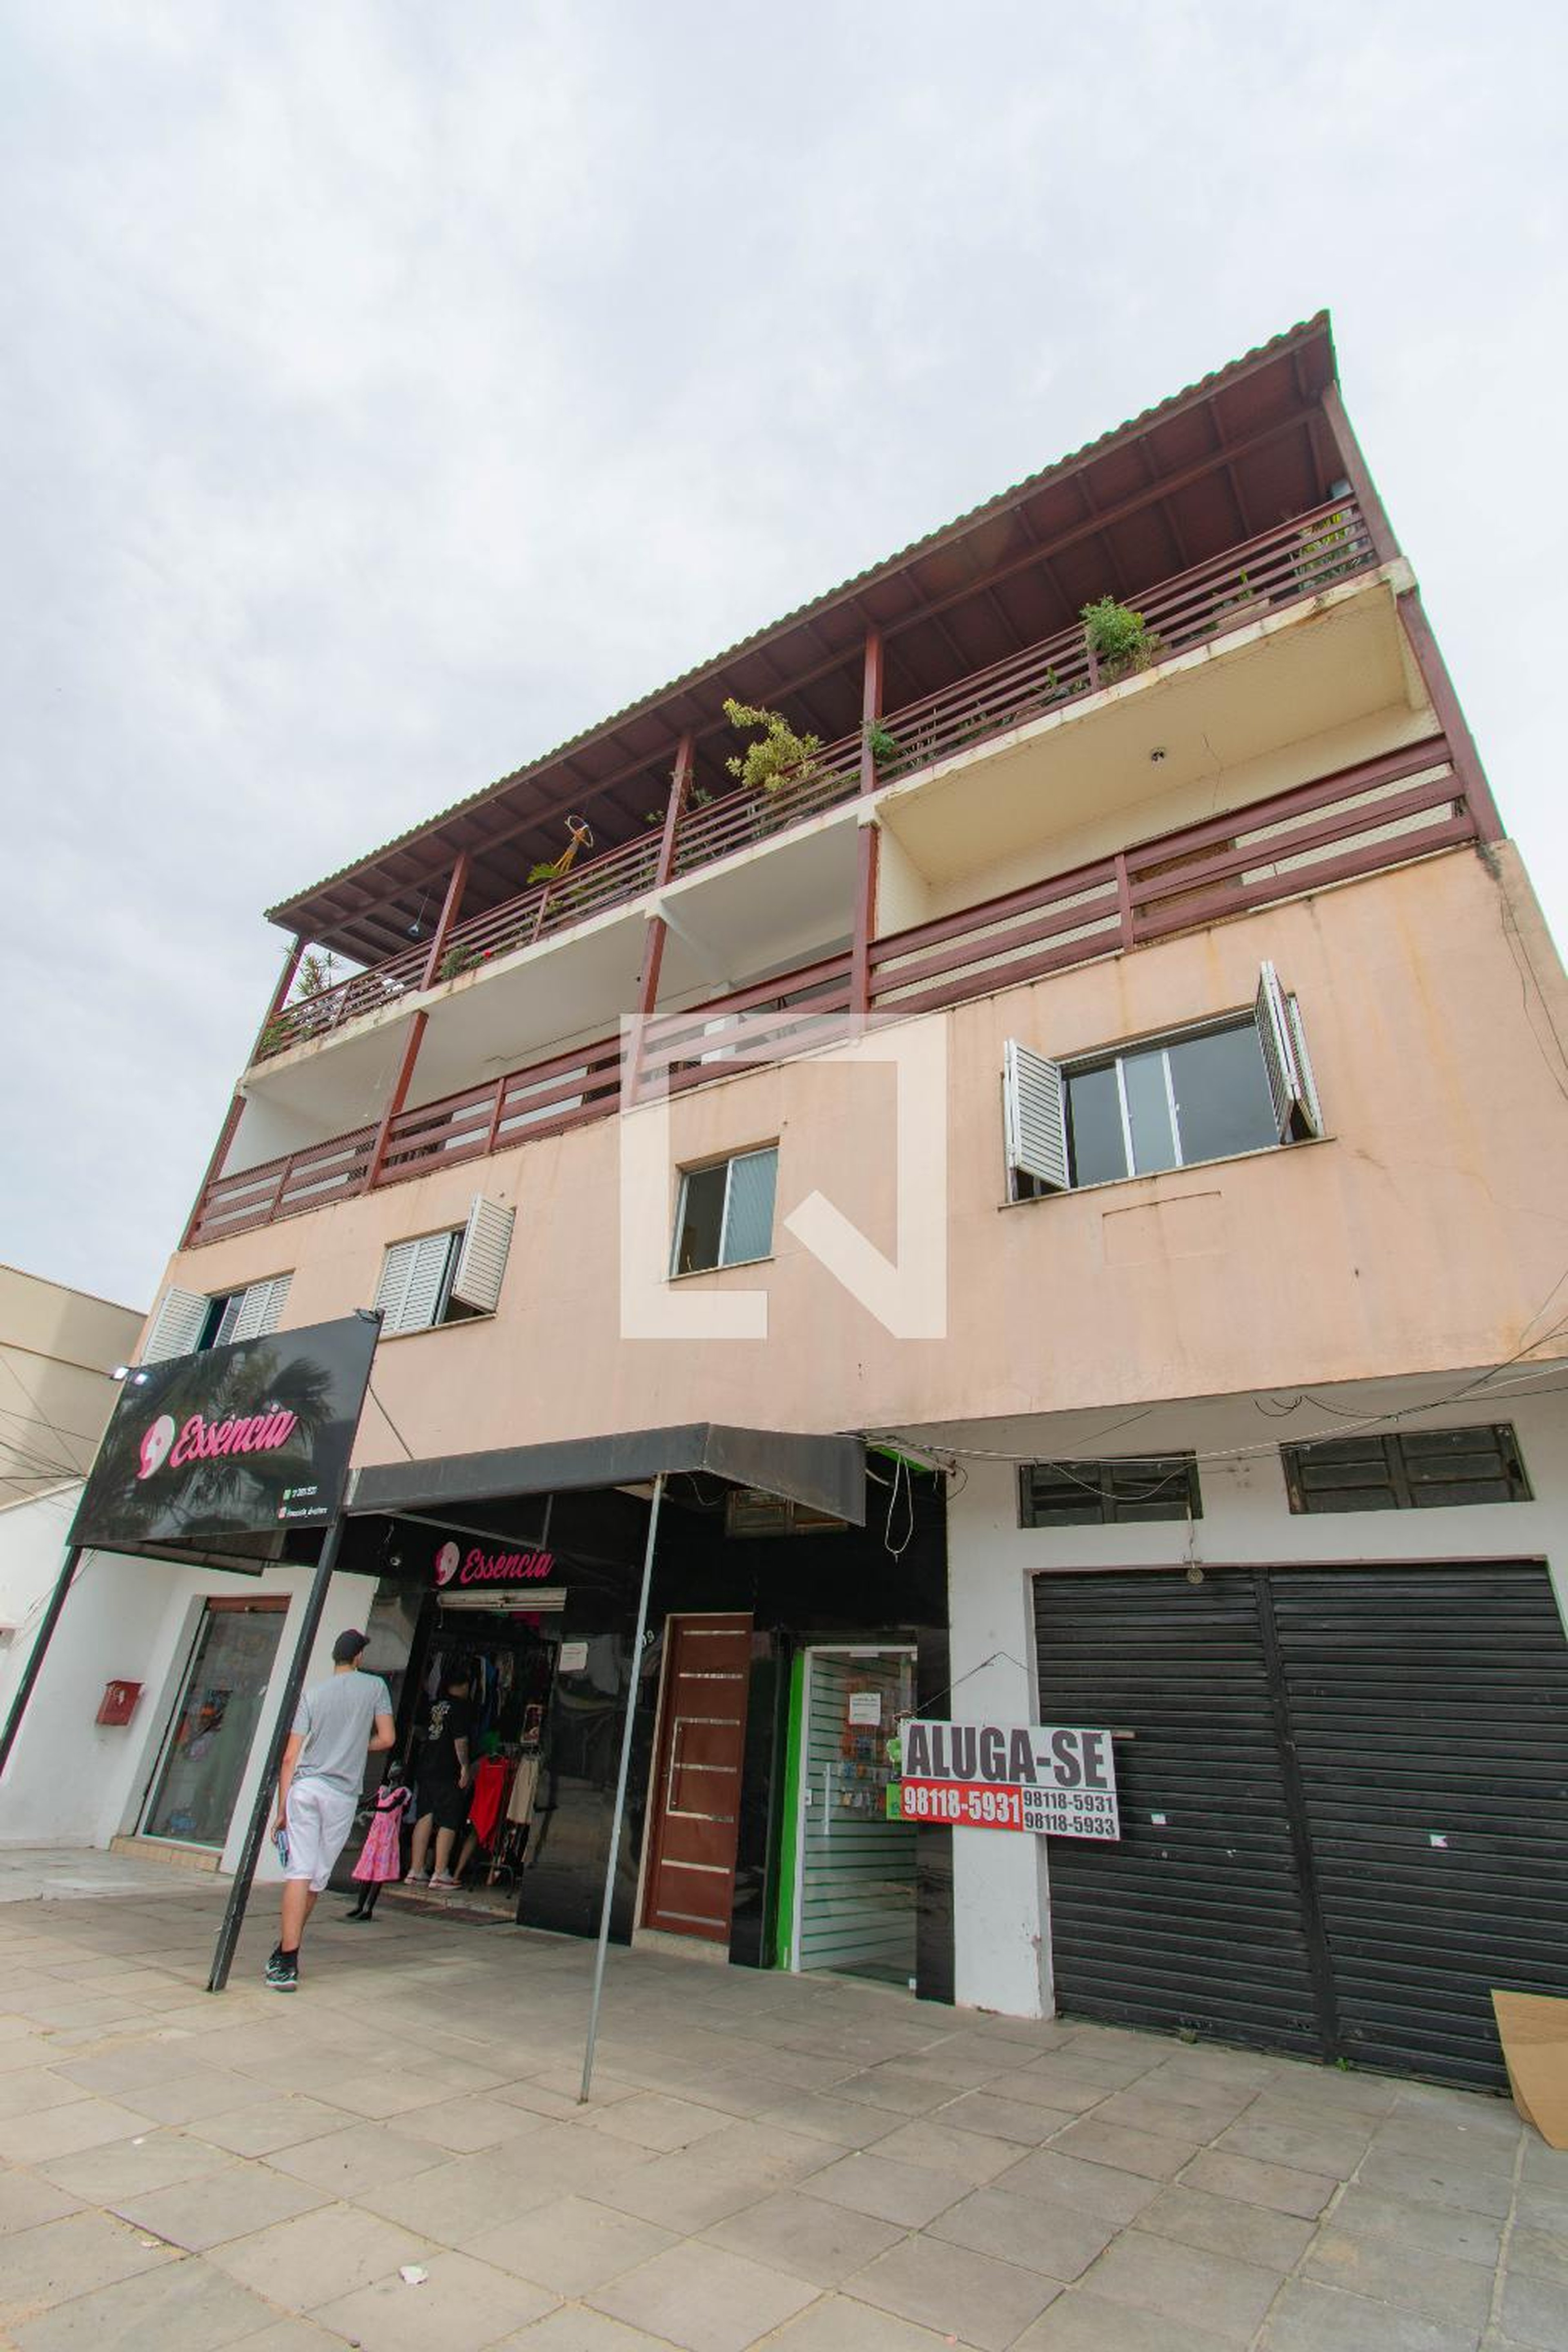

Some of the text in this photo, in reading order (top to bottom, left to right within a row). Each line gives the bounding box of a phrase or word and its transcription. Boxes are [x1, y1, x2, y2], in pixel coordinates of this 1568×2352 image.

[906, 1725, 1107, 1788] ALUGA-SE
[904, 1786, 1020, 1823] 98118-5931
[1024, 1790, 1114, 1813] 98118-5931
[1025, 1811, 1116, 1835] 98118-5933
